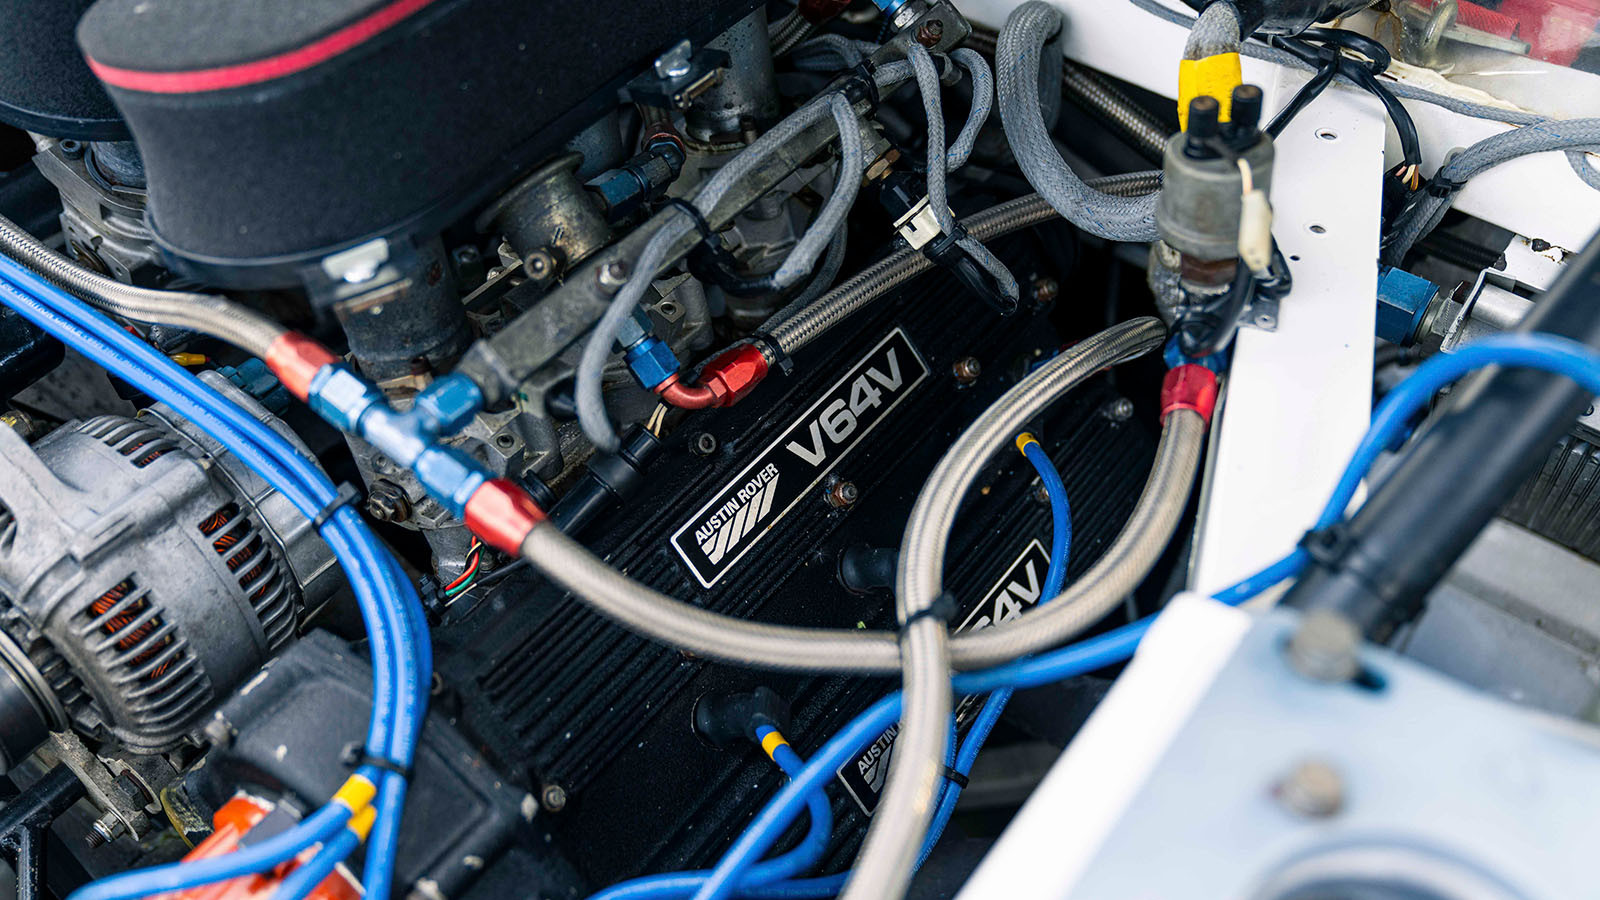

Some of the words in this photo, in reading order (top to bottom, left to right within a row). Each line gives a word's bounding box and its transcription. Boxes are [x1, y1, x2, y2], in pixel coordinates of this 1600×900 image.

[786, 347, 903, 467] V64V
[694, 497, 742, 546] AUSTIN
[737, 462, 779, 504] ROVER
[857, 724, 898, 776] AUSTIN
